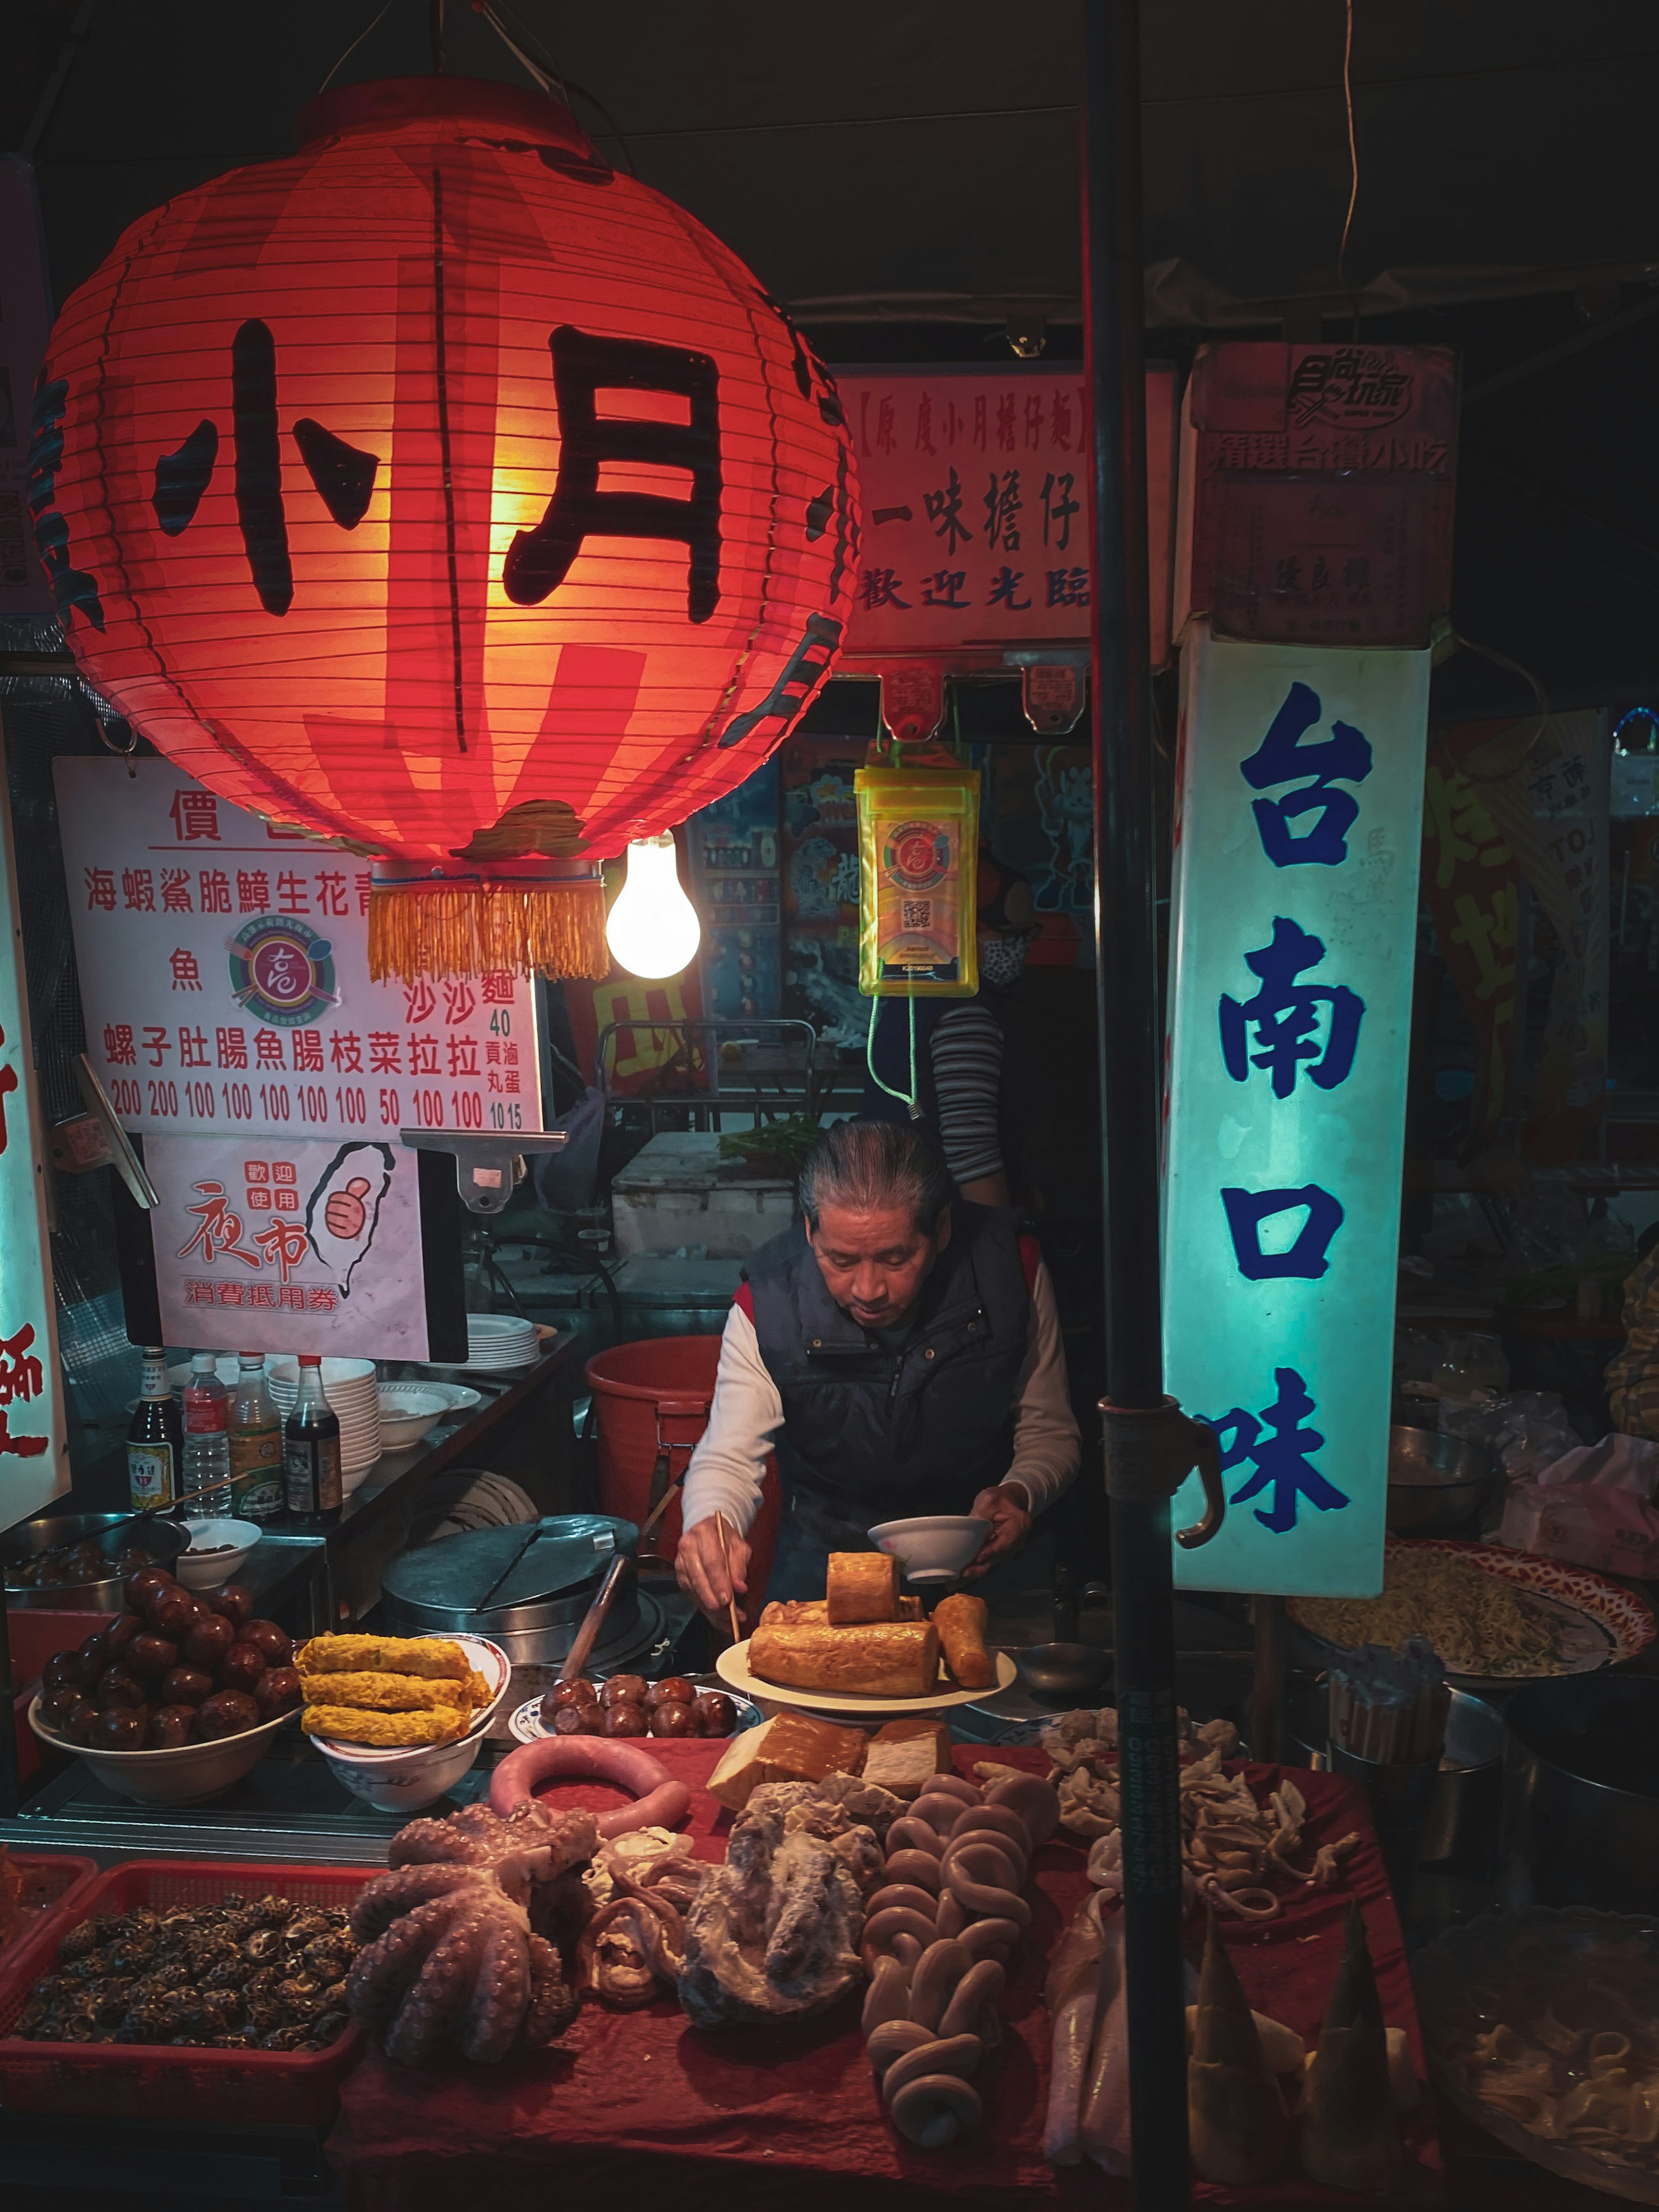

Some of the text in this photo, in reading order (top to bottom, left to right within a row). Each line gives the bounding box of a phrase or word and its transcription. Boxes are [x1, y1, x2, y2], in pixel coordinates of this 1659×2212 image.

[871, 466, 1081, 556] 一味擔仔
[859, 566, 1091, 611] 歡迎光臨
[489, 1008, 510, 1037] 40
[111, 1079, 142, 1116] 200
[147, 1080, 179, 1117] 200
[185, 1081, 215, 1119] 100
[222, 1082, 252, 1120] 100
[260, 1083, 290, 1122] 100
[297, 1084, 327, 1124] 100
[335, 1085, 367, 1124] 100
[485, 1041, 505, 1130] 貢丸 10
[503, 1041, 522, 1130] 滷蛋 15
[380, 1088, 400, 1126] 50
[413, 1089, 444, 1128] 100
[452, 1090, 482, 1129] 100
[1193, 681, 1373, 1534] 台南口味
[247, 1163, 294, 1182] 歡迎
[249, 1190, 296, 1210] 使用
[178, 1180, 310, 1284] 夜市
[184, 1279, 339, 1312] 消費抵用券
